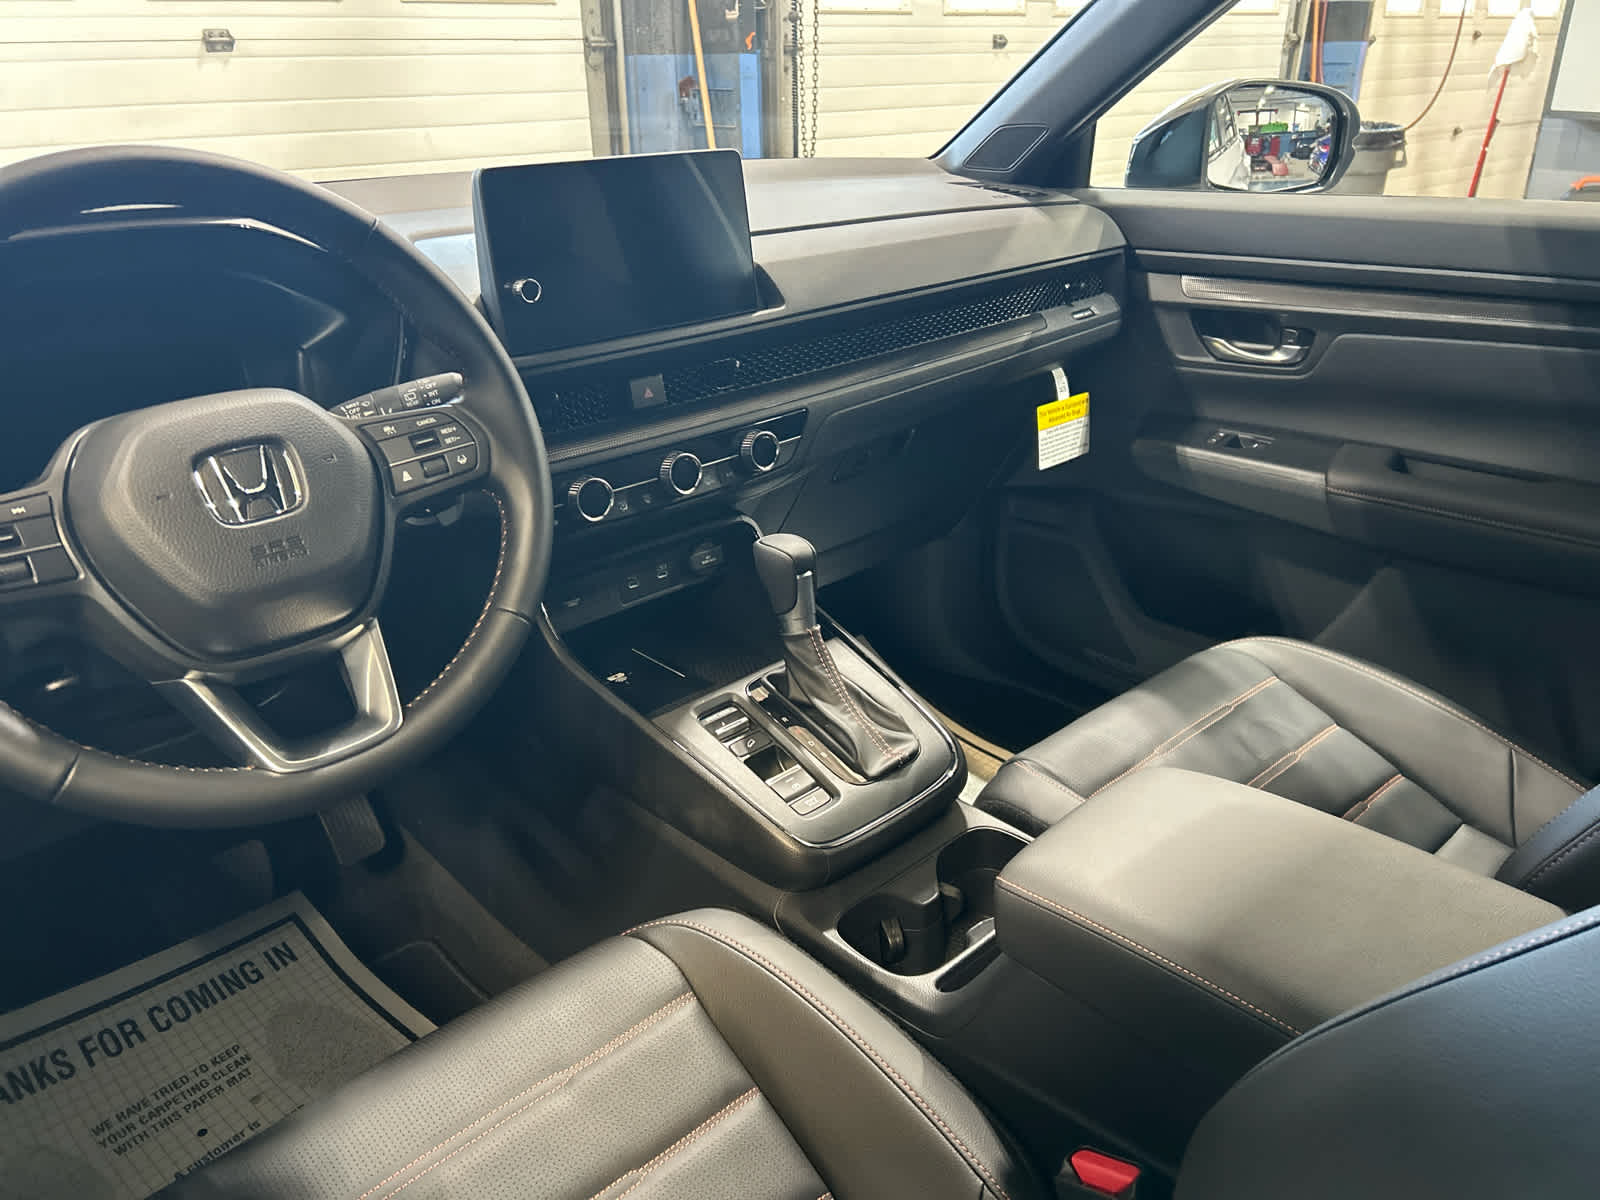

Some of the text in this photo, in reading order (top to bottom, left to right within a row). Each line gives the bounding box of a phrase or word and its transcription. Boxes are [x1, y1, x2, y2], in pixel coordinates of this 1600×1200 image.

[78, 1019, 147, 1068] FOR
[147, 959, 265, 1032] COMING
[263, 942, 298, 972] IN
[91, 1044, 241, 1137] WE HAVE TRIED TO KEEP
[98, 1054, 252, 1149] YOUR CARPETING CLEAN
[112, 1068, 252, 1157] WITH THIS PAPER MAT
[248, 1120, 261, 1132] is
